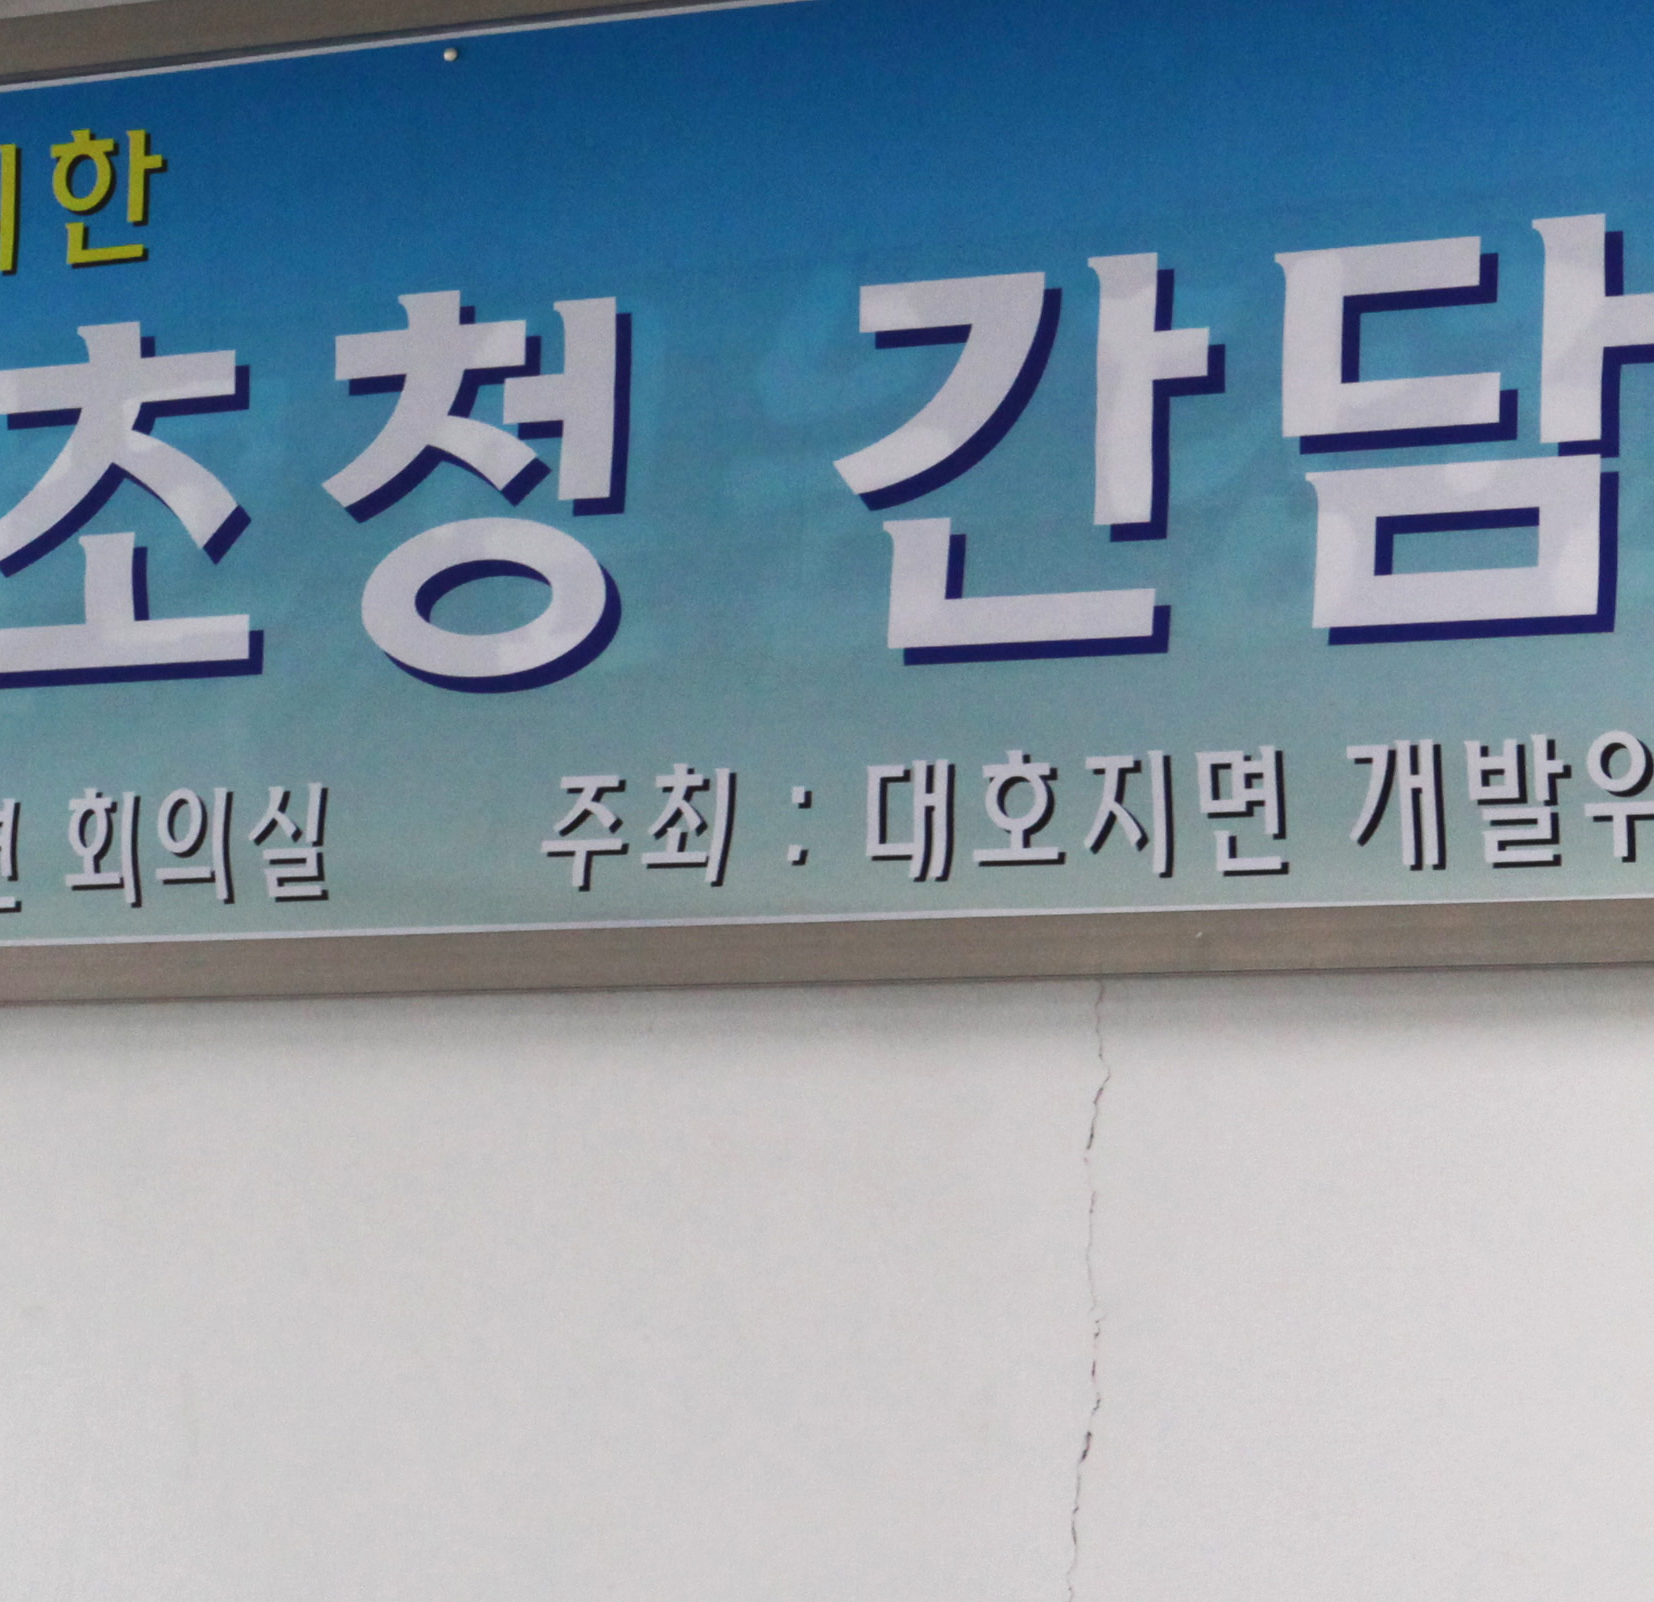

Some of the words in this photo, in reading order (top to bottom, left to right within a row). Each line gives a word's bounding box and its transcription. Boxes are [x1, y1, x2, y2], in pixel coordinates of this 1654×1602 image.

[832, 213, 1654, 664] 간담
[64, 781, 330, 906] 회의실
[540, 761, 739, 890] 주최
[864, 745, 1290, 882] 대호지면
